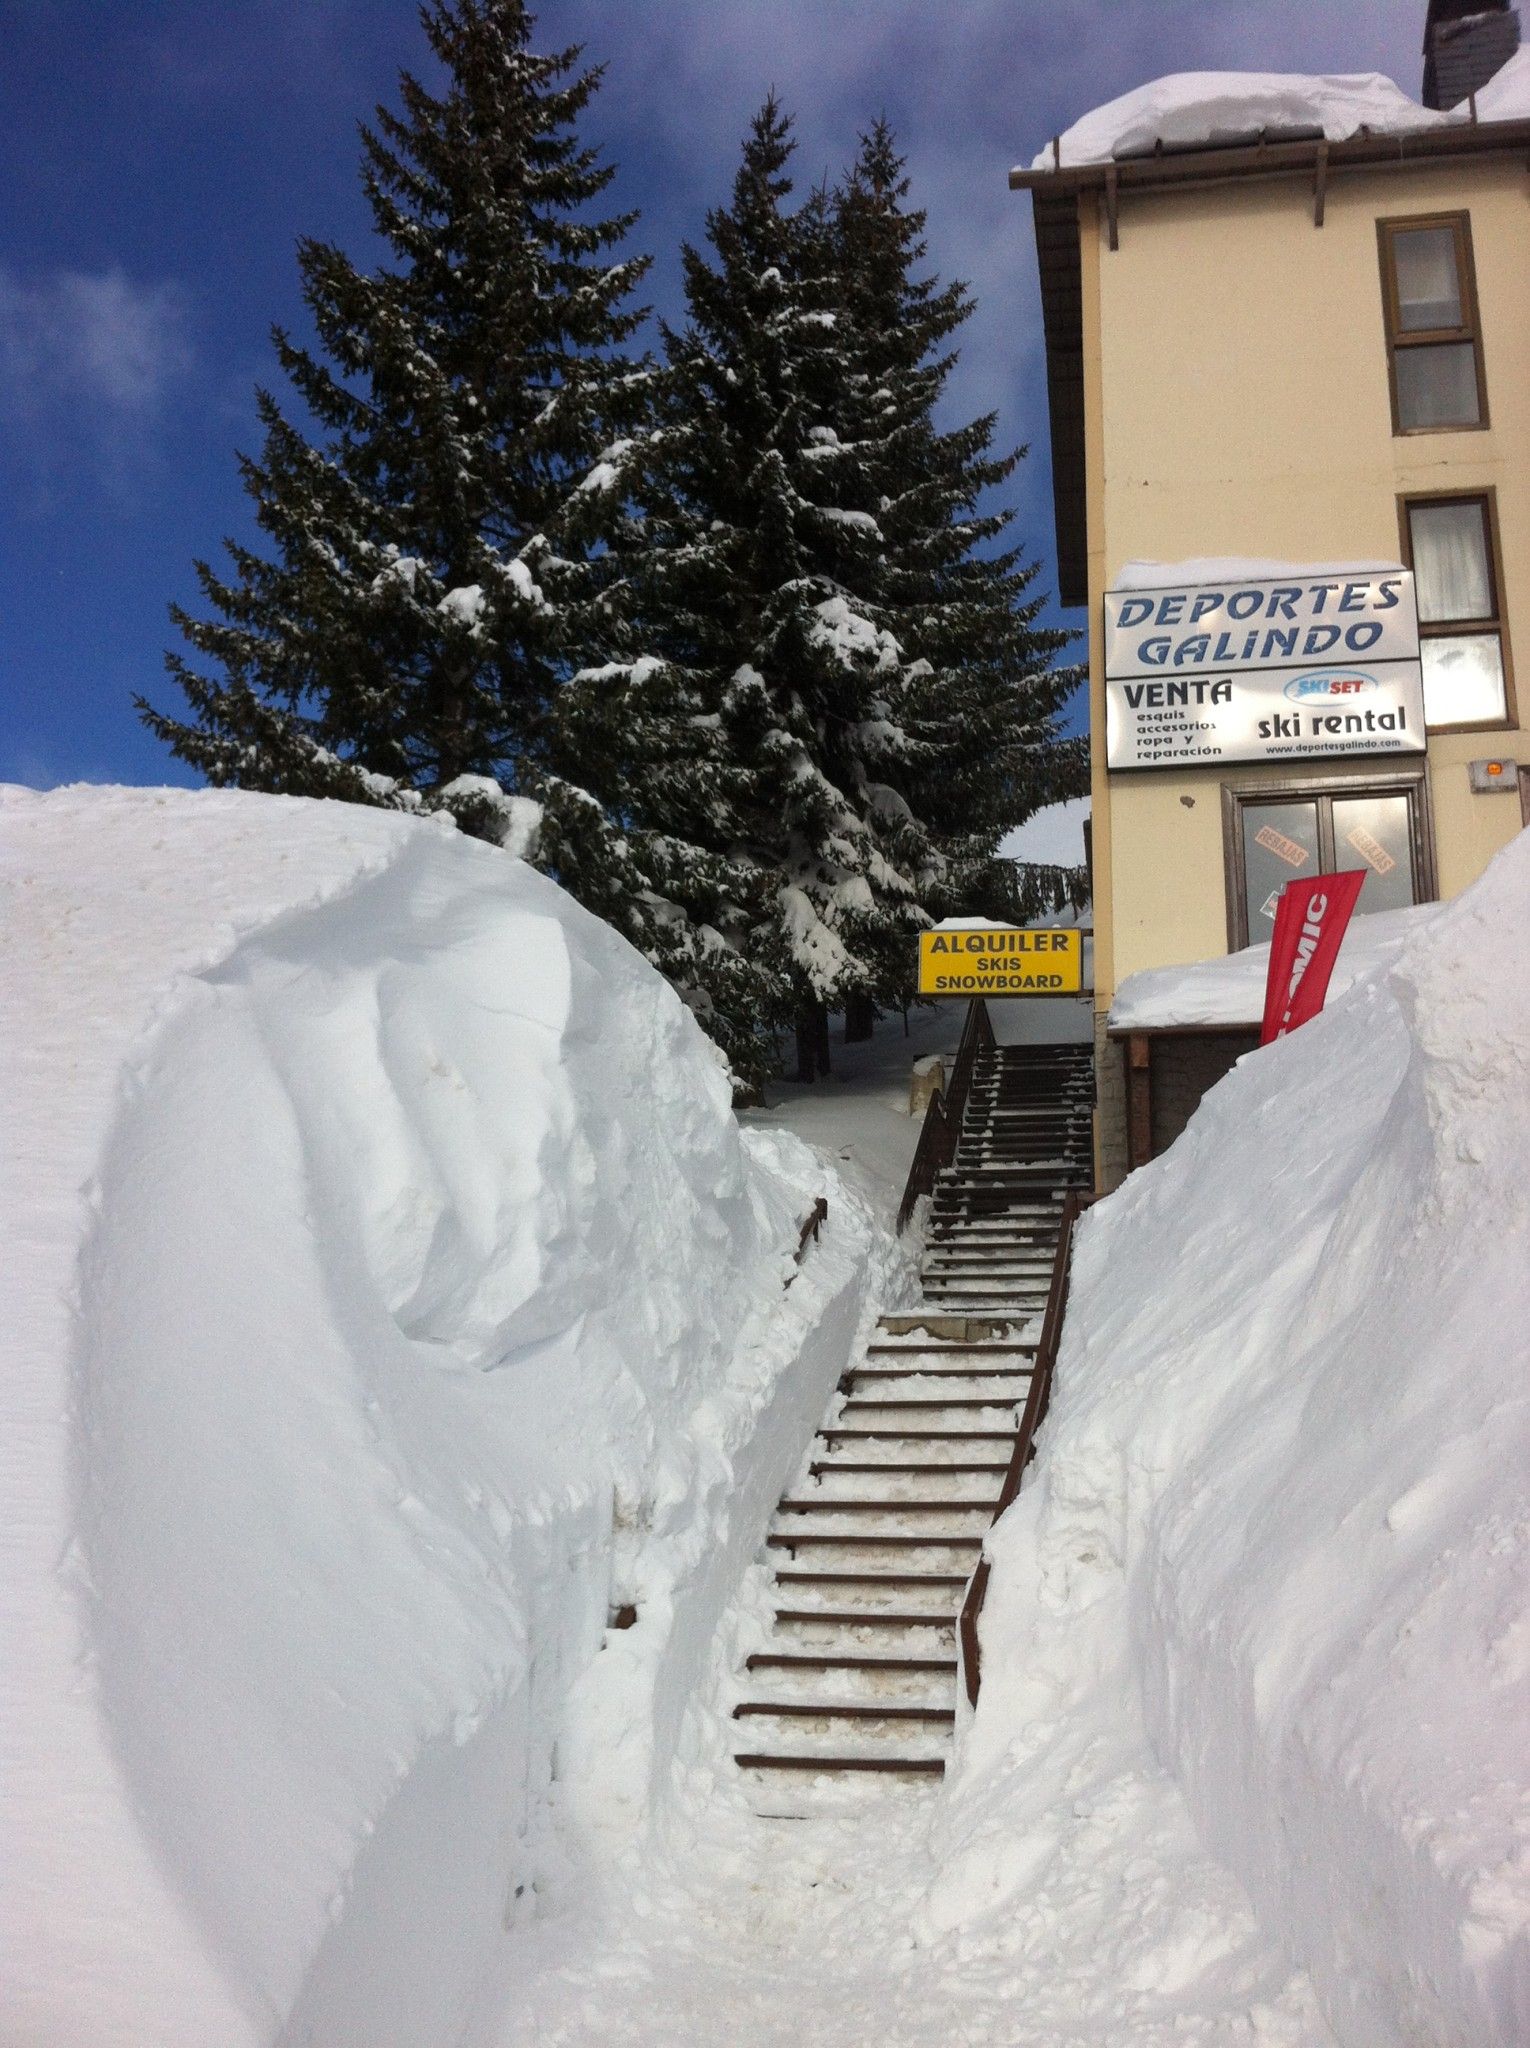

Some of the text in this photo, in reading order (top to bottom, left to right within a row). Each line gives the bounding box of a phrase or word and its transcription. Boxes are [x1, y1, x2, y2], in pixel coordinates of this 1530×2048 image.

[1116, 579, 1402, 628] DEPORTES
[1123, 678, 1232, 709] VENTA
[1137, 710, 1185, 722] esquis
[1258, 705, 1406, 739] ski rental
[1137, 720, 1217, 734] accesorios
[1136, 735, 1194, 747] ropa y
[1265, 738, 1401, 754] www.deportesgalindo.com
[1137, 745, 1222, 760] reparación
[1259, 828, 1305, 864] REBAJAS
[930, 933, 1069, 953] ALQUILER
[976, 957, 1022, 971] SKIS
[935, 974, 1063, 989] SNOWBOARD
